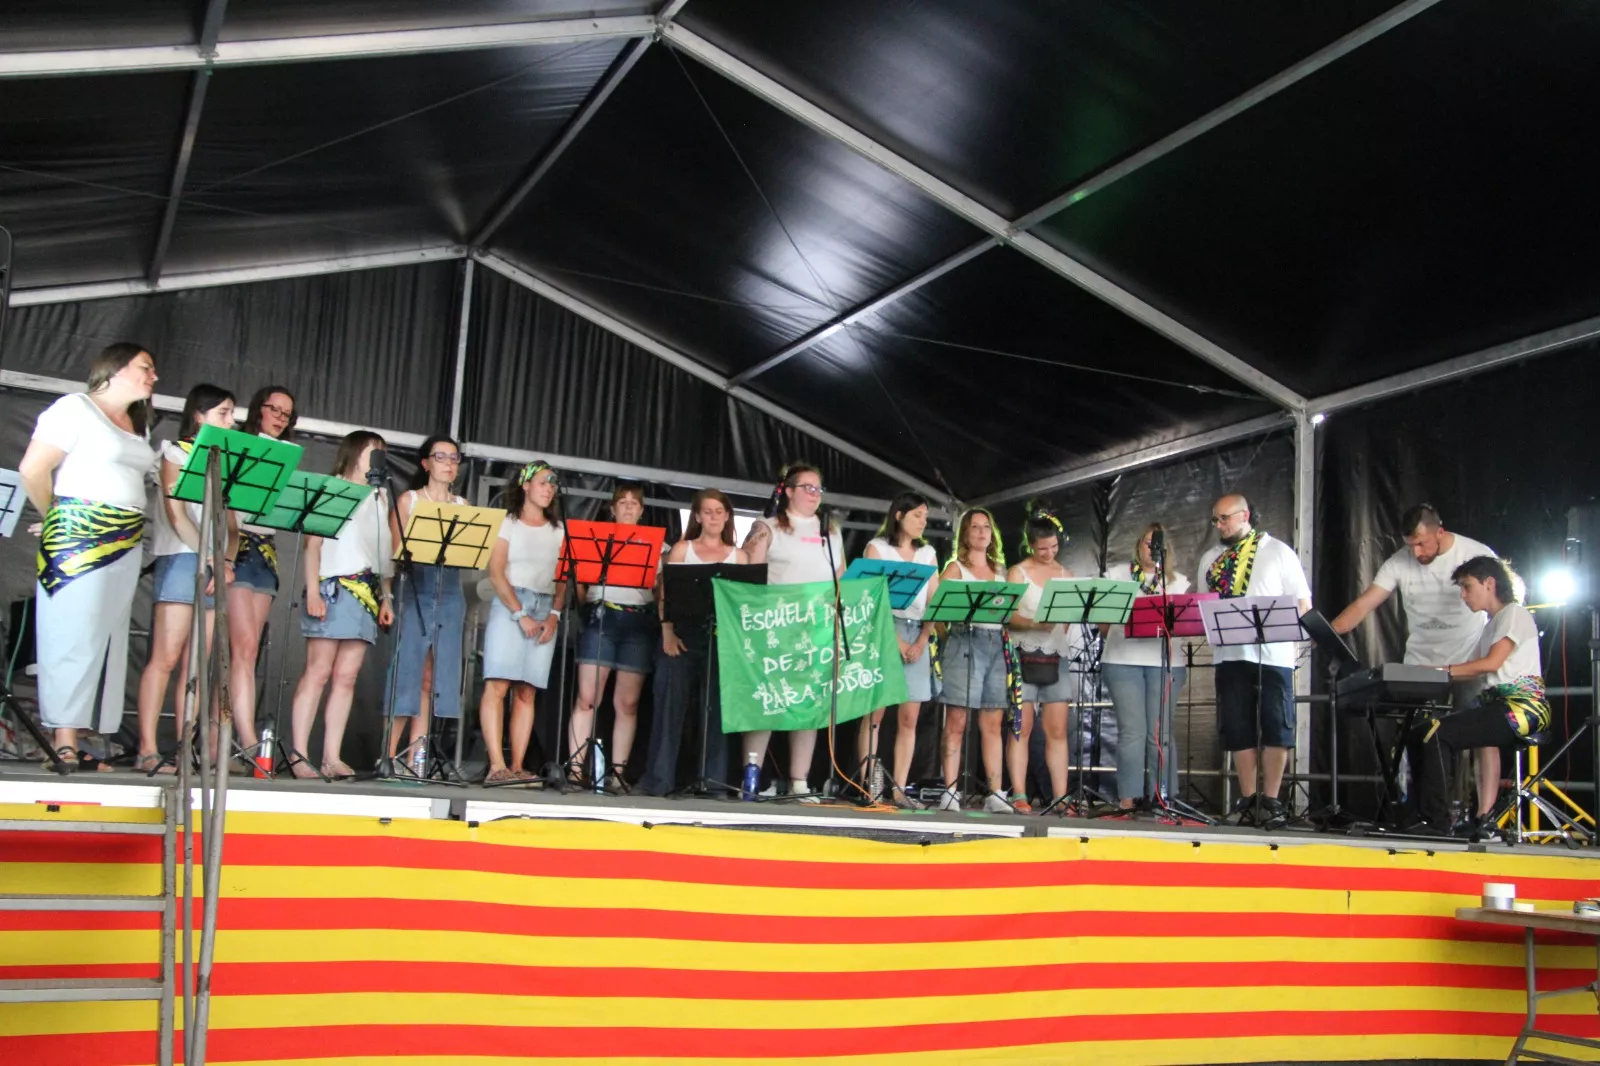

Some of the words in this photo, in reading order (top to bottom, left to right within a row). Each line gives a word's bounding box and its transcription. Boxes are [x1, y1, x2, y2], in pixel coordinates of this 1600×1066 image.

[741, 602, 816, 631] ESCUELA
[763, 654, 793, 674] DE
[762, 684, 816, 710] PARA
[821, 667, 884, 697] TOD@S
